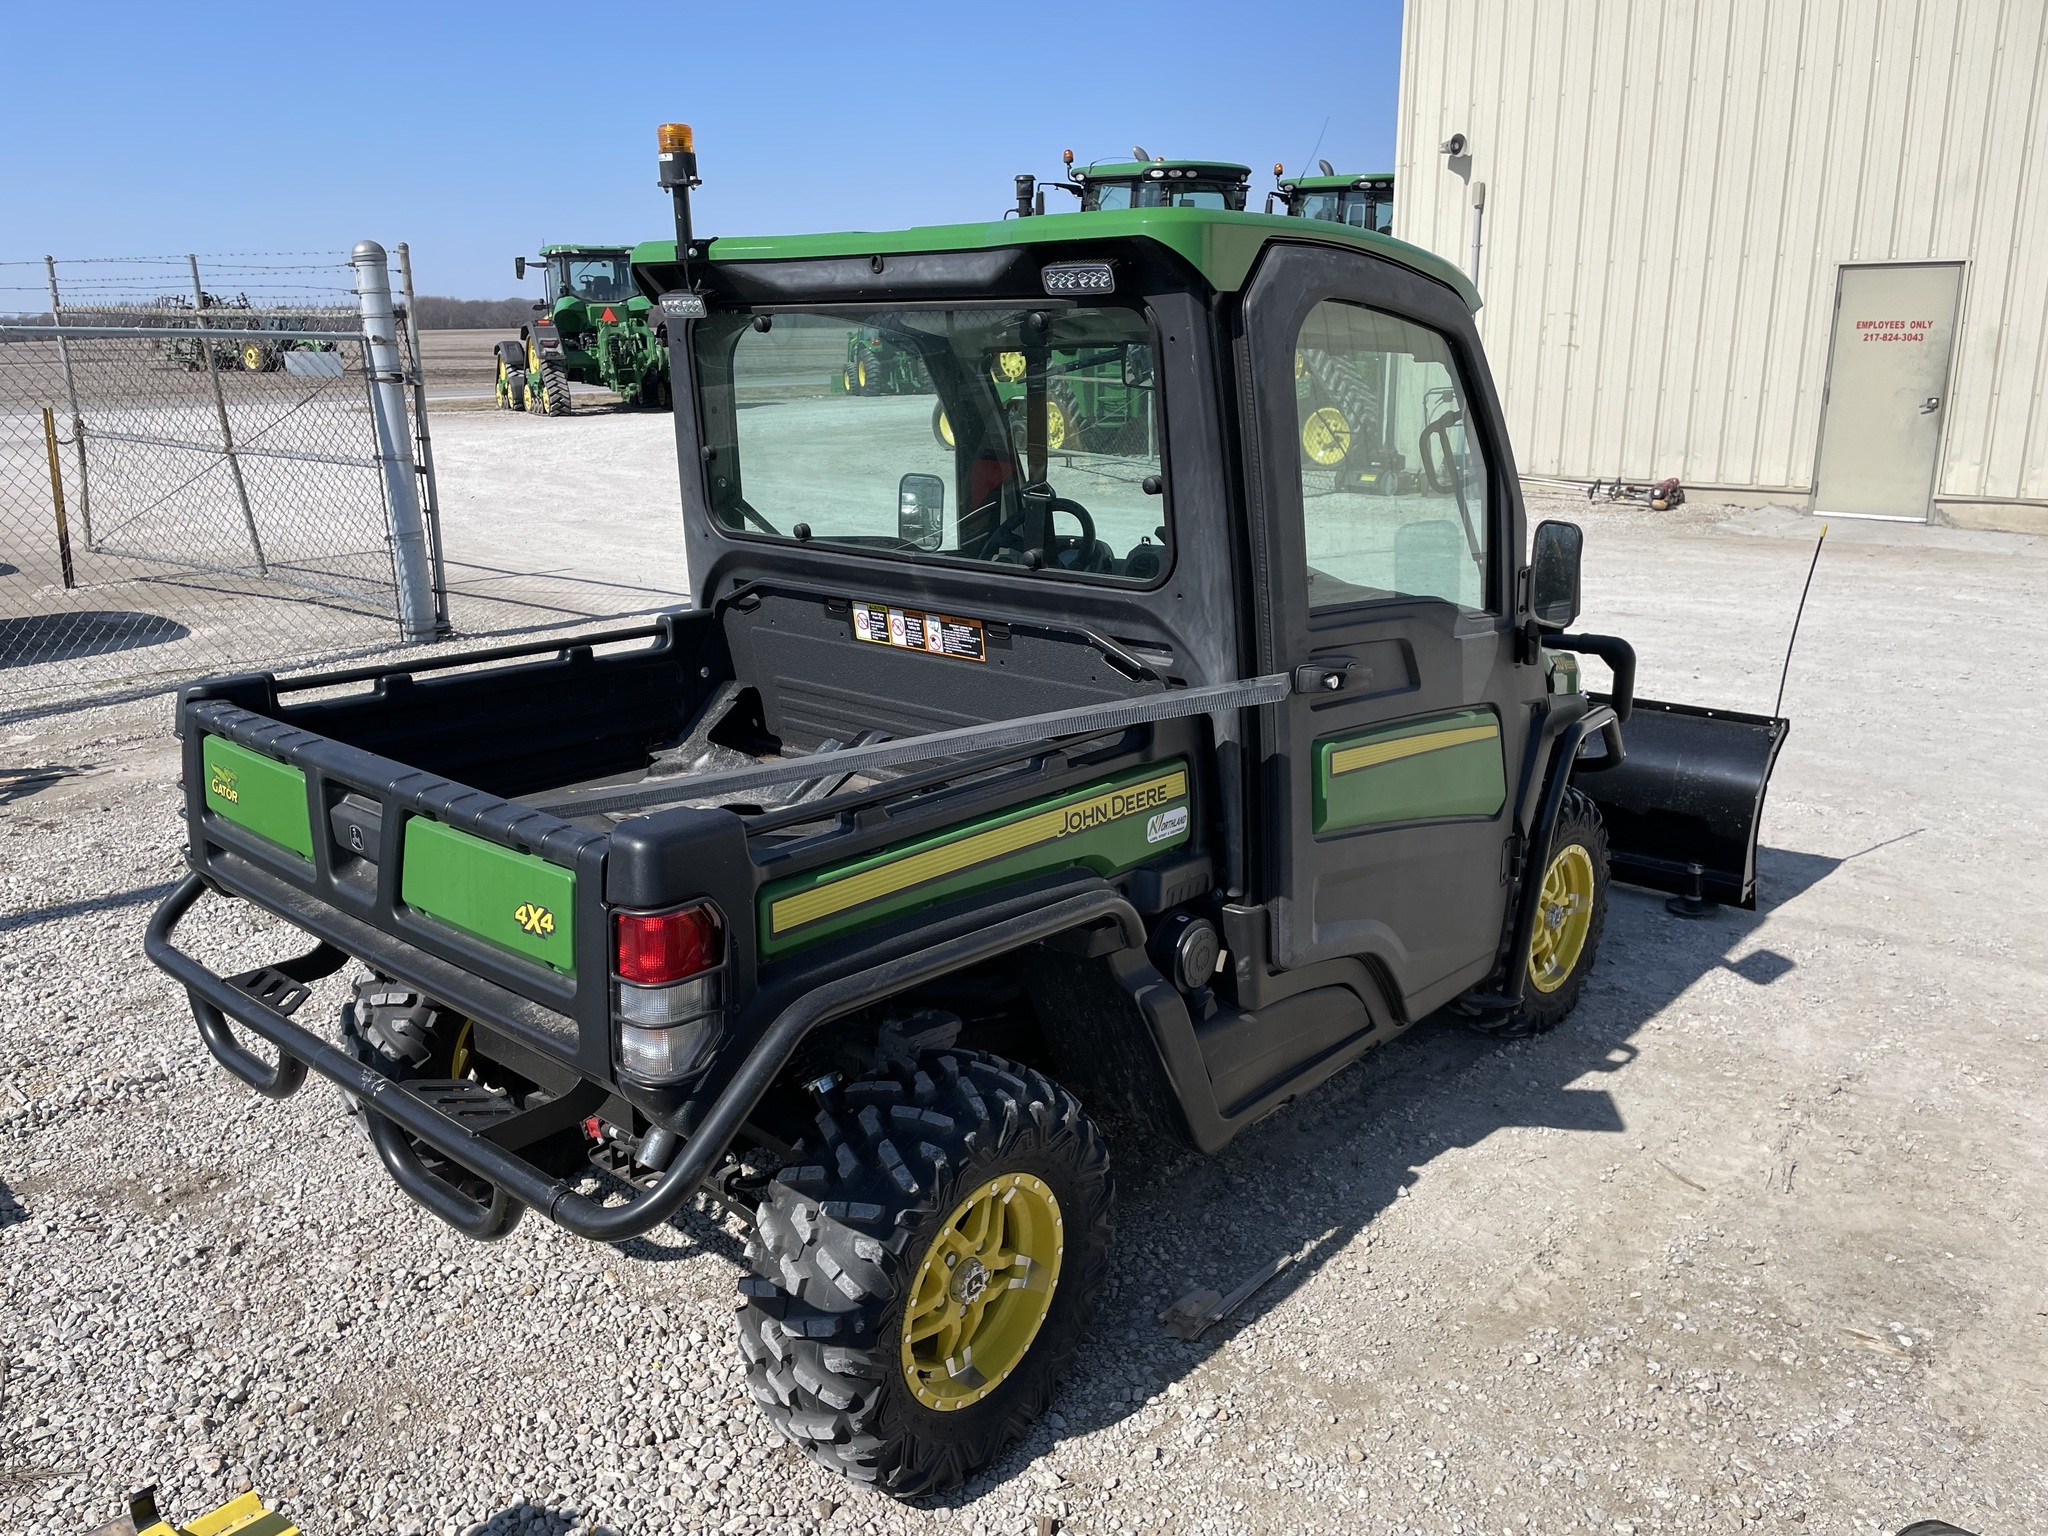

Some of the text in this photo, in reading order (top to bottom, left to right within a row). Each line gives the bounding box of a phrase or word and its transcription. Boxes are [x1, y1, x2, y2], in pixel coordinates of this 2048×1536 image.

[1856, 320, 1934, 330] EMPLOYEES ONLY
[1863, 333, 1924, 342] 217-824-3043
[211, 778, 239, 805] GATOR
[1058, 784, 1168, 835] JOHN DEERE
[514, 902, 555, 938] 4X4
